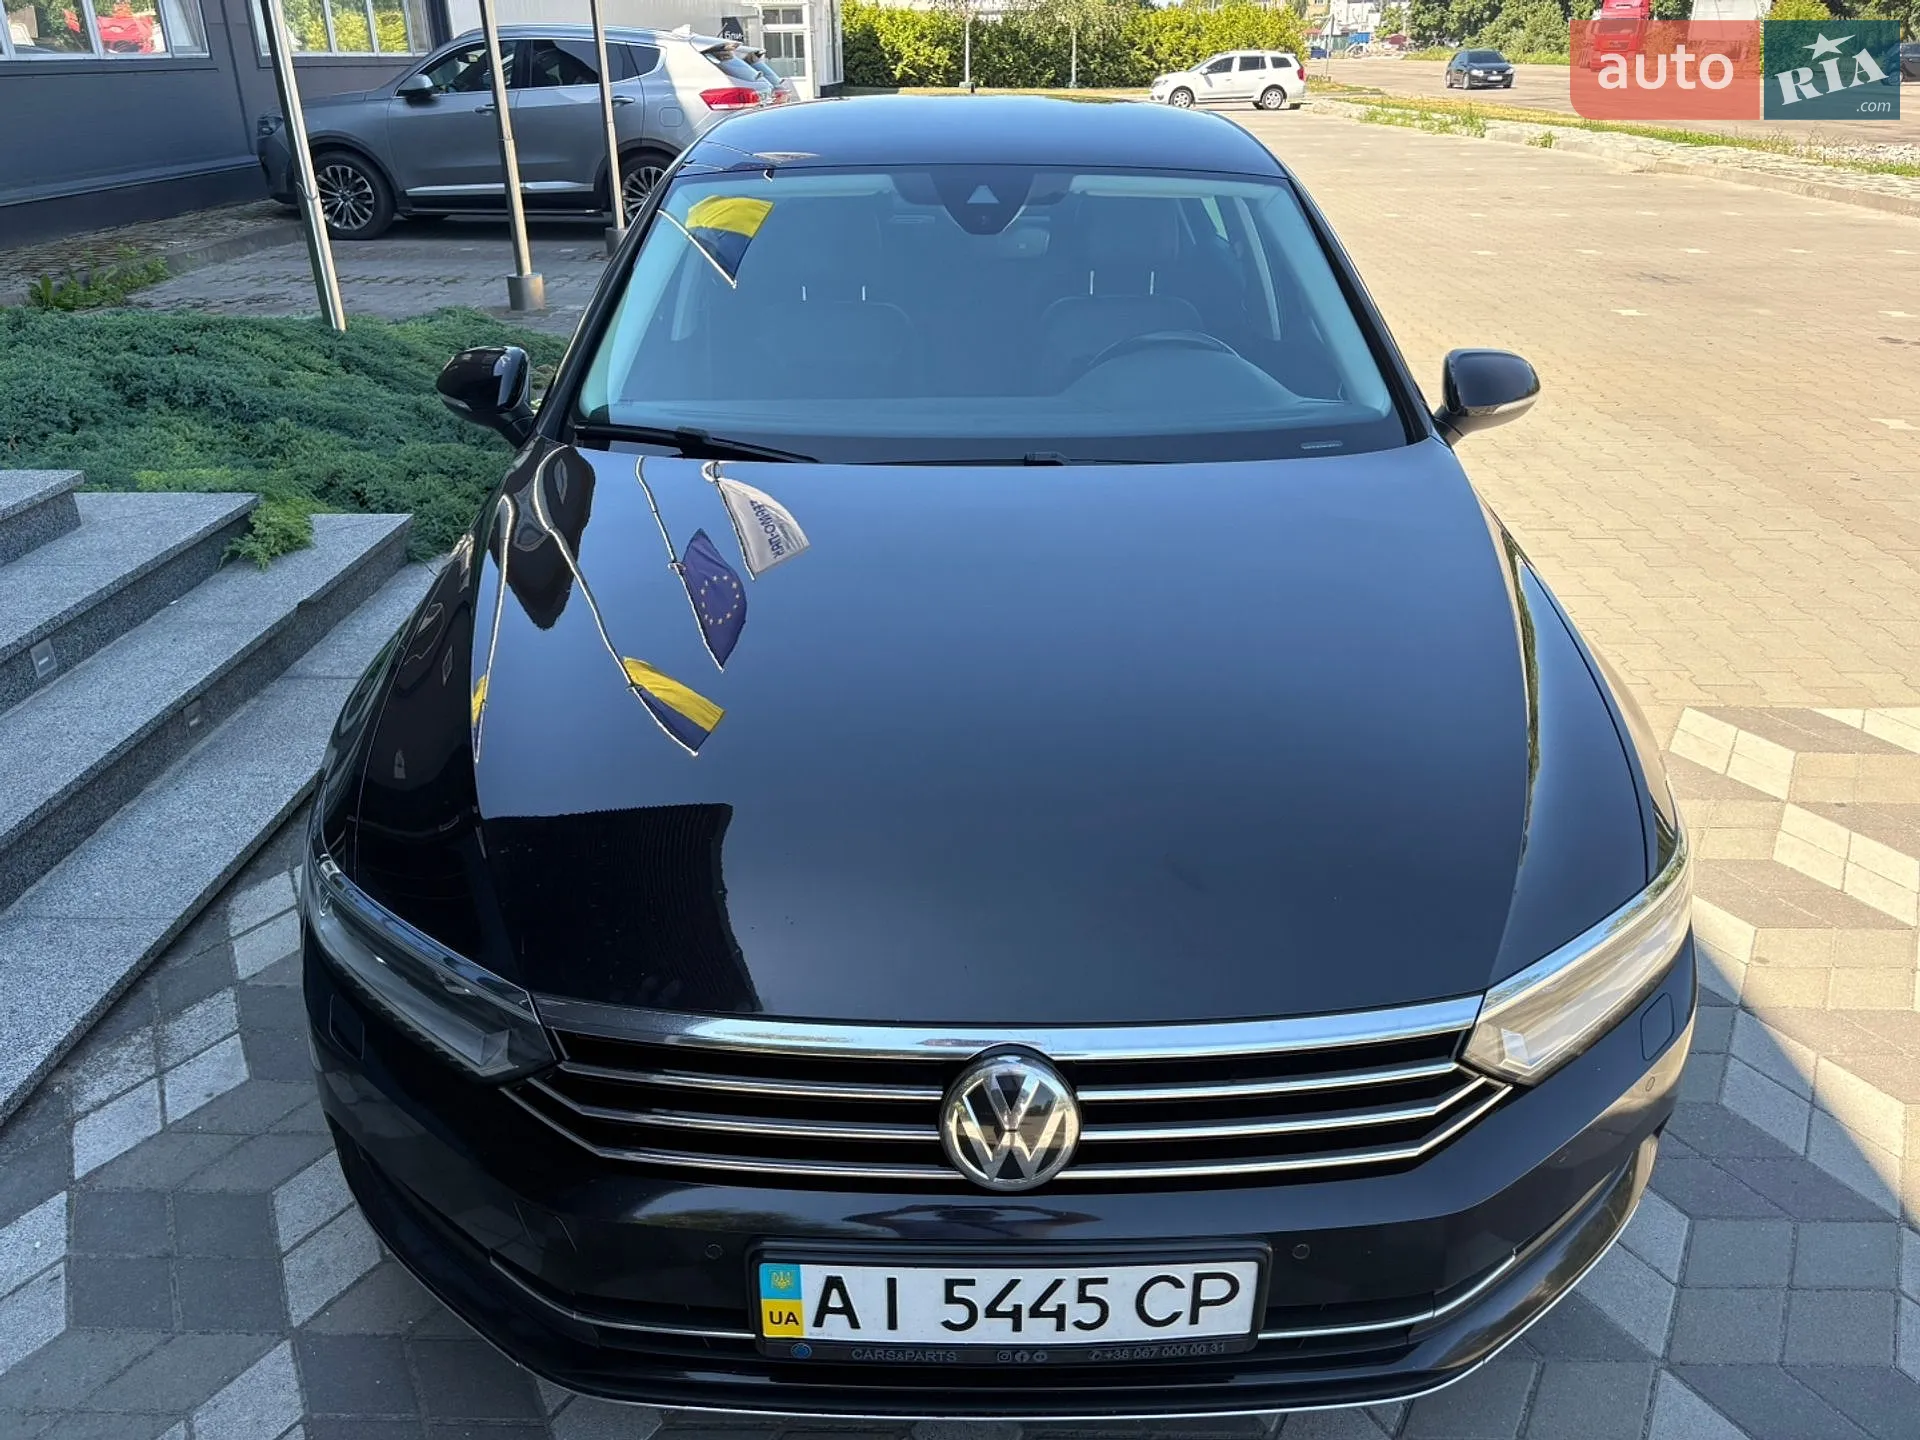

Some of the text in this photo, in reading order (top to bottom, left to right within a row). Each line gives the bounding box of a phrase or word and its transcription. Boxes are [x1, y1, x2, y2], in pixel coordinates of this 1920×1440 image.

[940, 1276, 1111, 1333] 5445
[1134, 1271, 1241, 1329] CP
[769, 1311, 800, 1326] UA
[851, 1349, 957, 1363] CARS&PARTS
